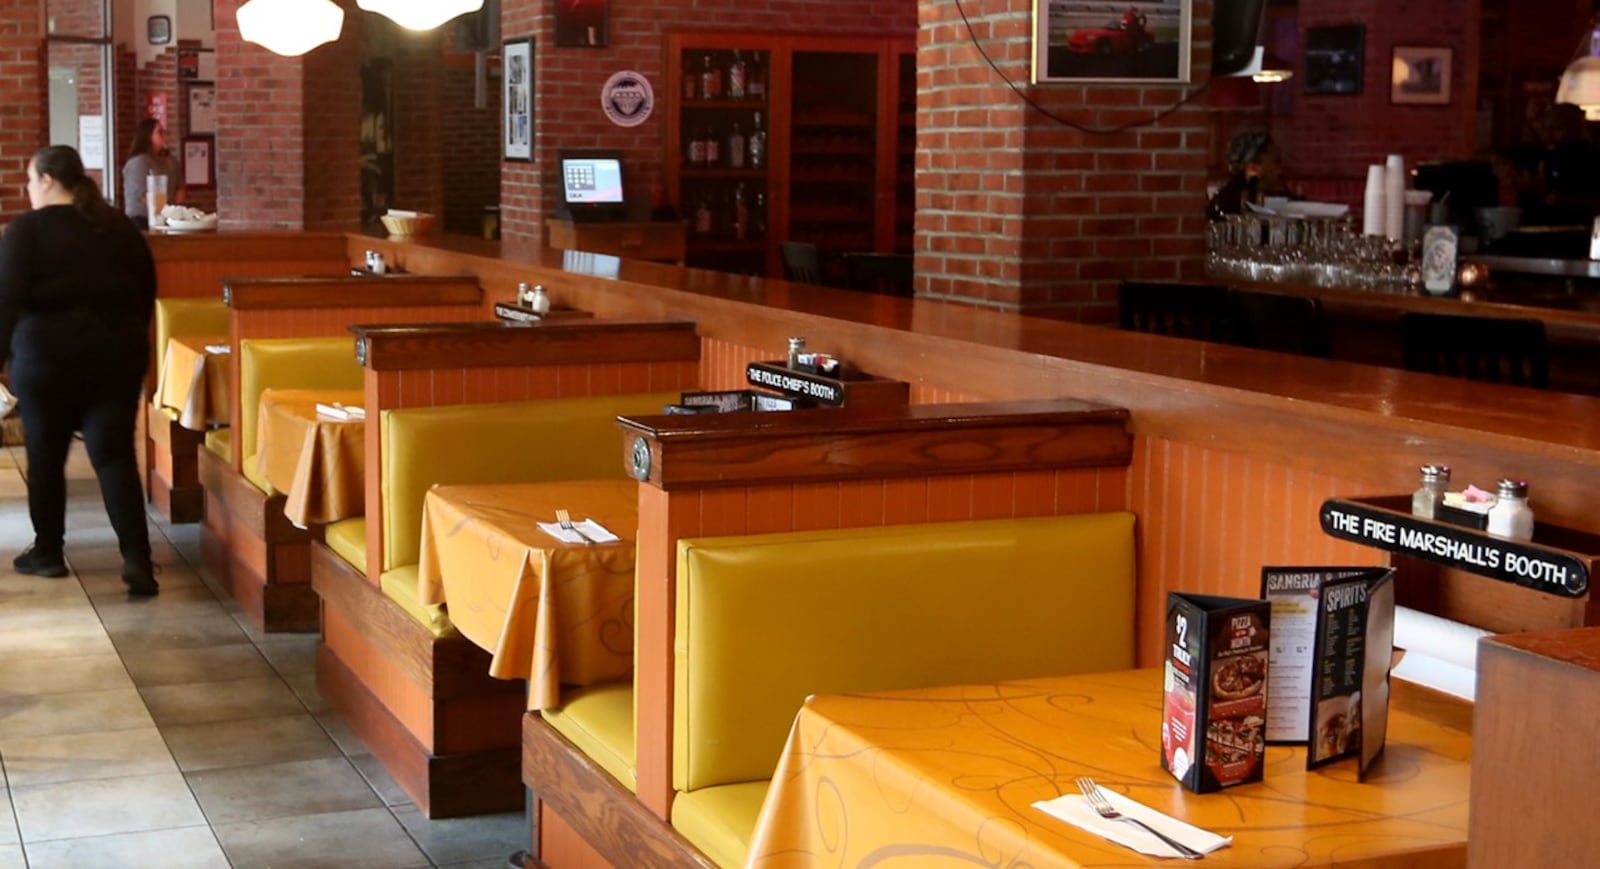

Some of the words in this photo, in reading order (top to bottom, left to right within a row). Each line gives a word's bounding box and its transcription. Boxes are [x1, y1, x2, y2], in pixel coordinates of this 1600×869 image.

[749, 368, 761, 382] THE
[762, 371, 782, 387] POLICE
[782, 376, 809, 394] CHIEF'S
[810, 382, 834, 400] BOOTH
[1331, 510, 1360, 534] THE
[1363, 518, 1396, 543] FIRE
[1399, 527, 1500, 568] MARSHALL'S
[1505, 553, 1567, 585] BOOTH
[1269, 573, 1321, 590] SANGRIA
[1327, 584, 1367, 611] SPIRITS
[1232, 615, 1251, 630] PIZZA
